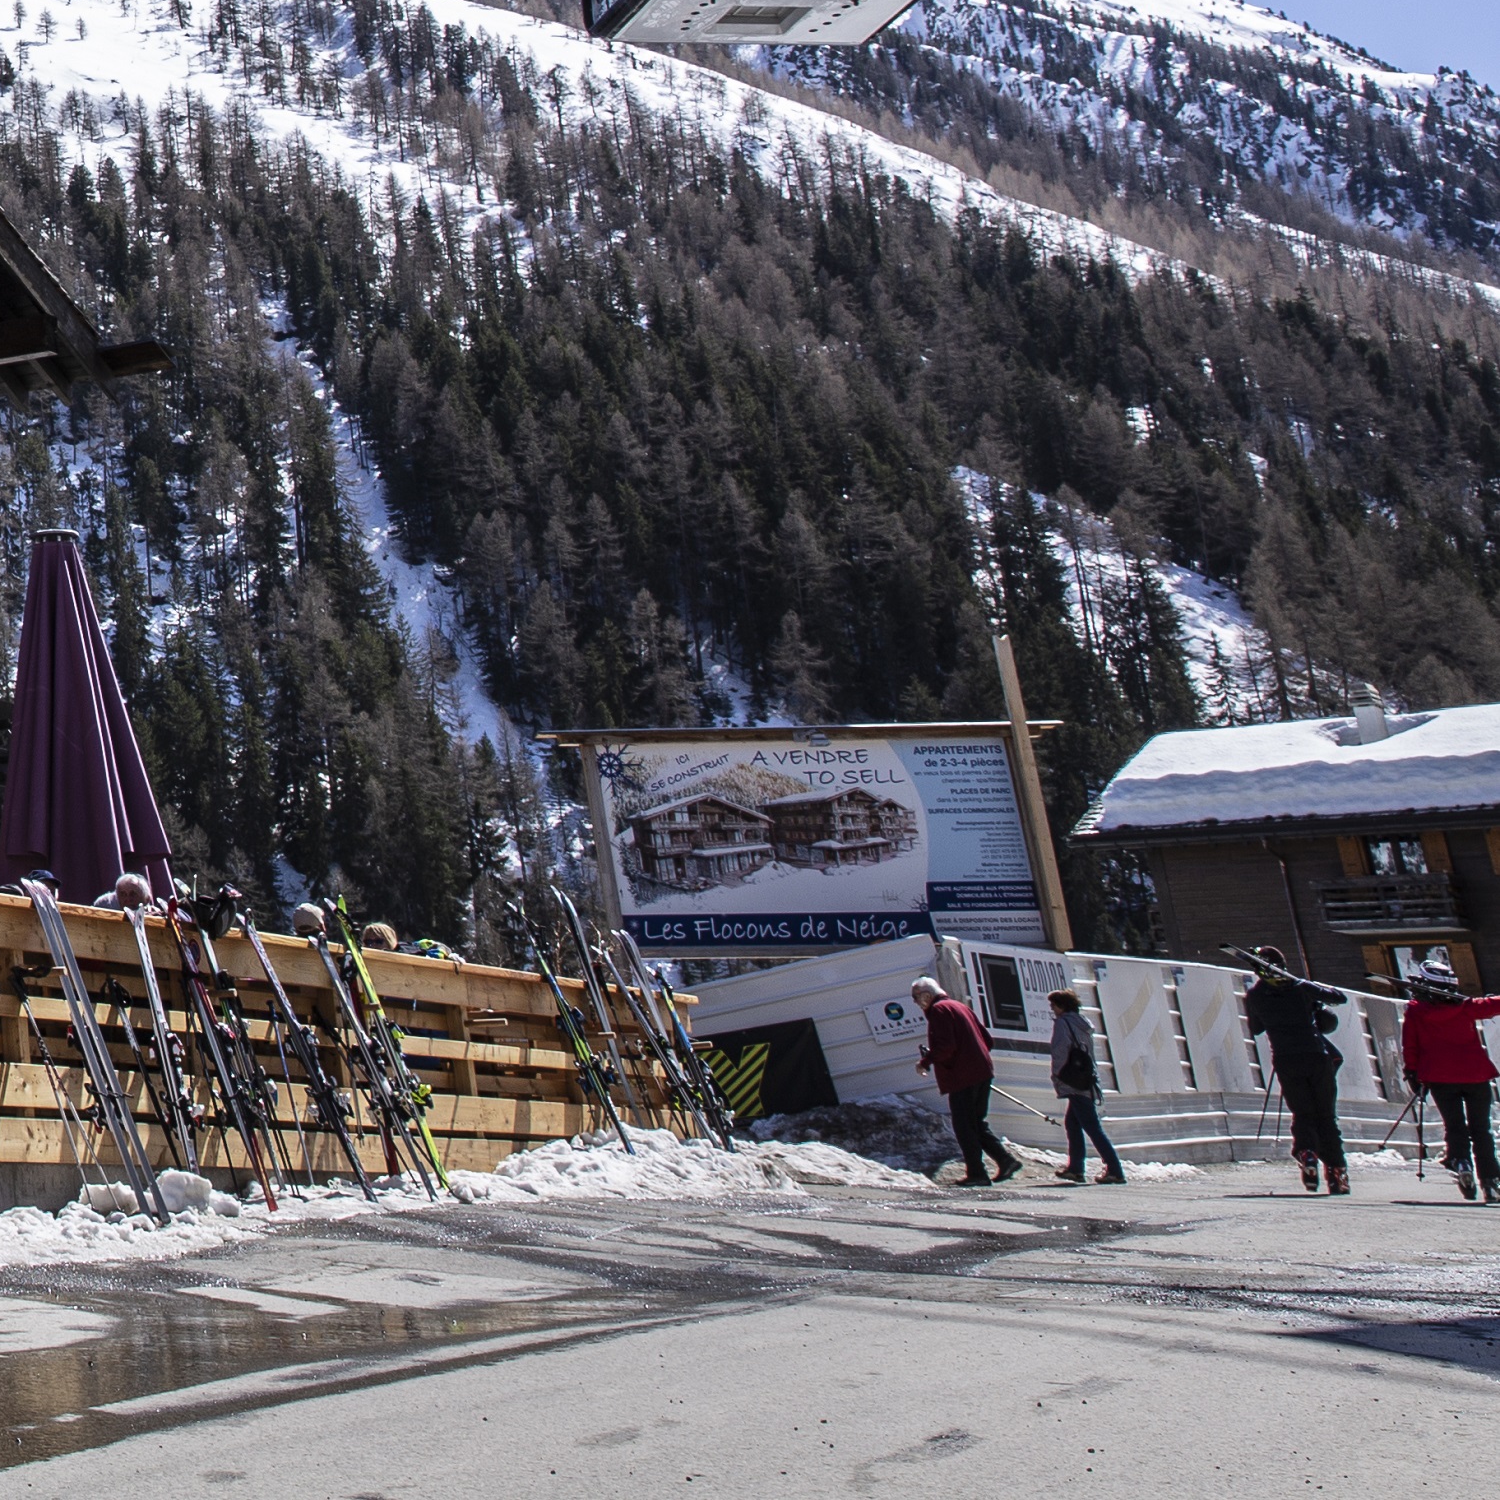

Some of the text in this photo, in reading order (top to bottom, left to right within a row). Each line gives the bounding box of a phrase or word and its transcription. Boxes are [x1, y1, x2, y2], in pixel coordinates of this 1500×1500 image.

[750, 749, 869, 766] A VENDRE
[913, 745, 1003, 755] APPARTEMENTS
[675, 754, 690, 766] ICI
[924, 758, 1005, 769] de 2-3-4 pièces
[650, 753, 731, 792] SE CONSTRUIT
[803, 768, 906, 785] TO SELL
[643, 914, 910, 940] Les Flocons de Neige
